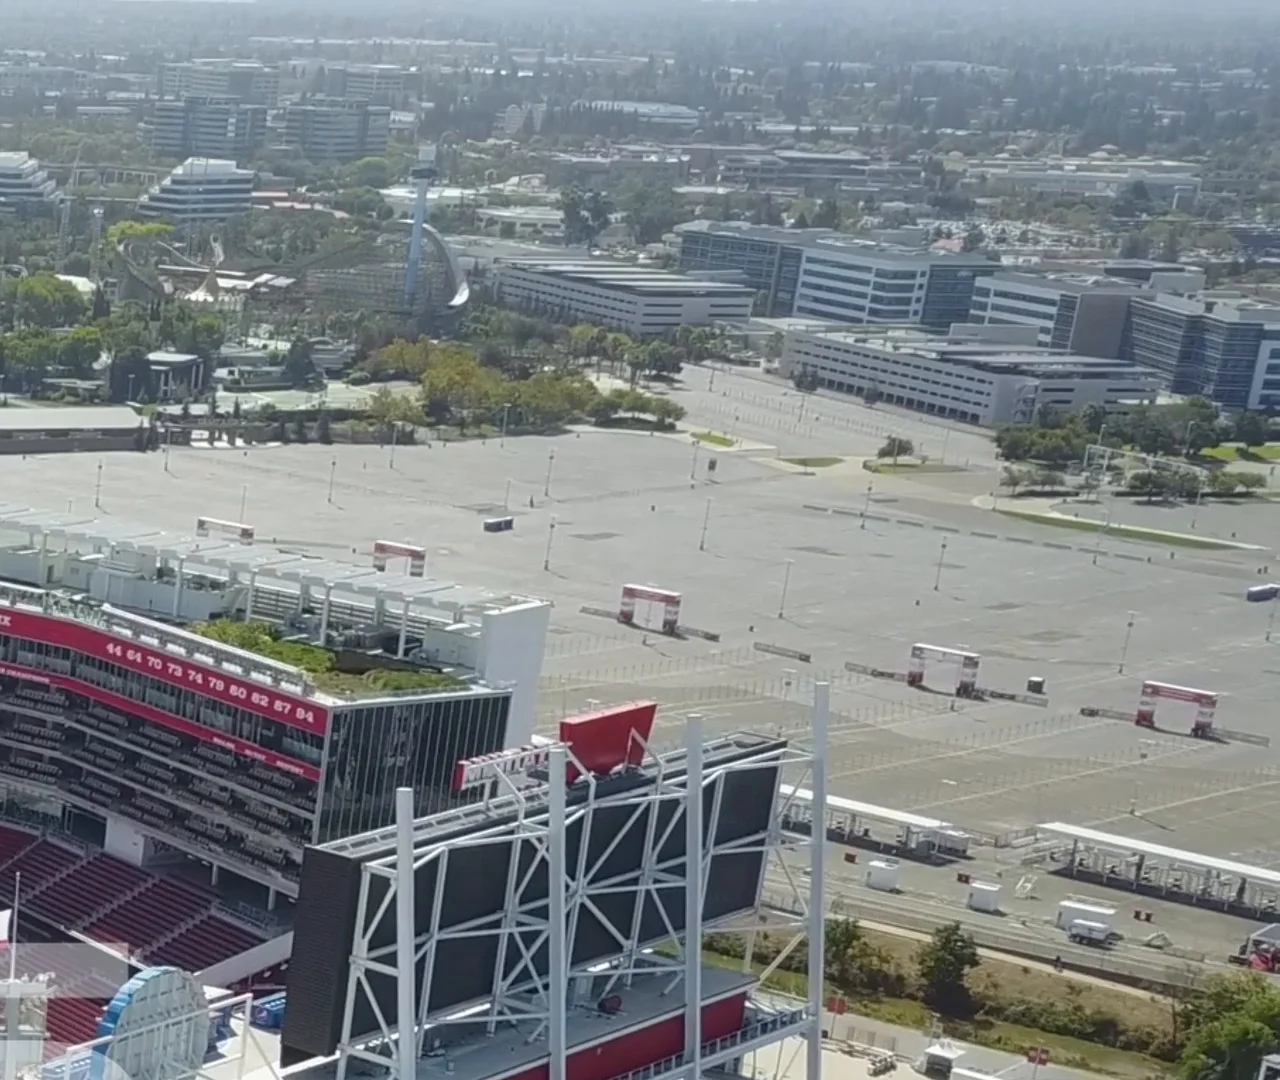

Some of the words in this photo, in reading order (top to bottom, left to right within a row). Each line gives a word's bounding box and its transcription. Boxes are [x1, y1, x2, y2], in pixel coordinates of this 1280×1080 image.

[106, 642, 122, 656] 44
[147, 655, 162, 670] 70
[187, 669, 203, 684] 74
